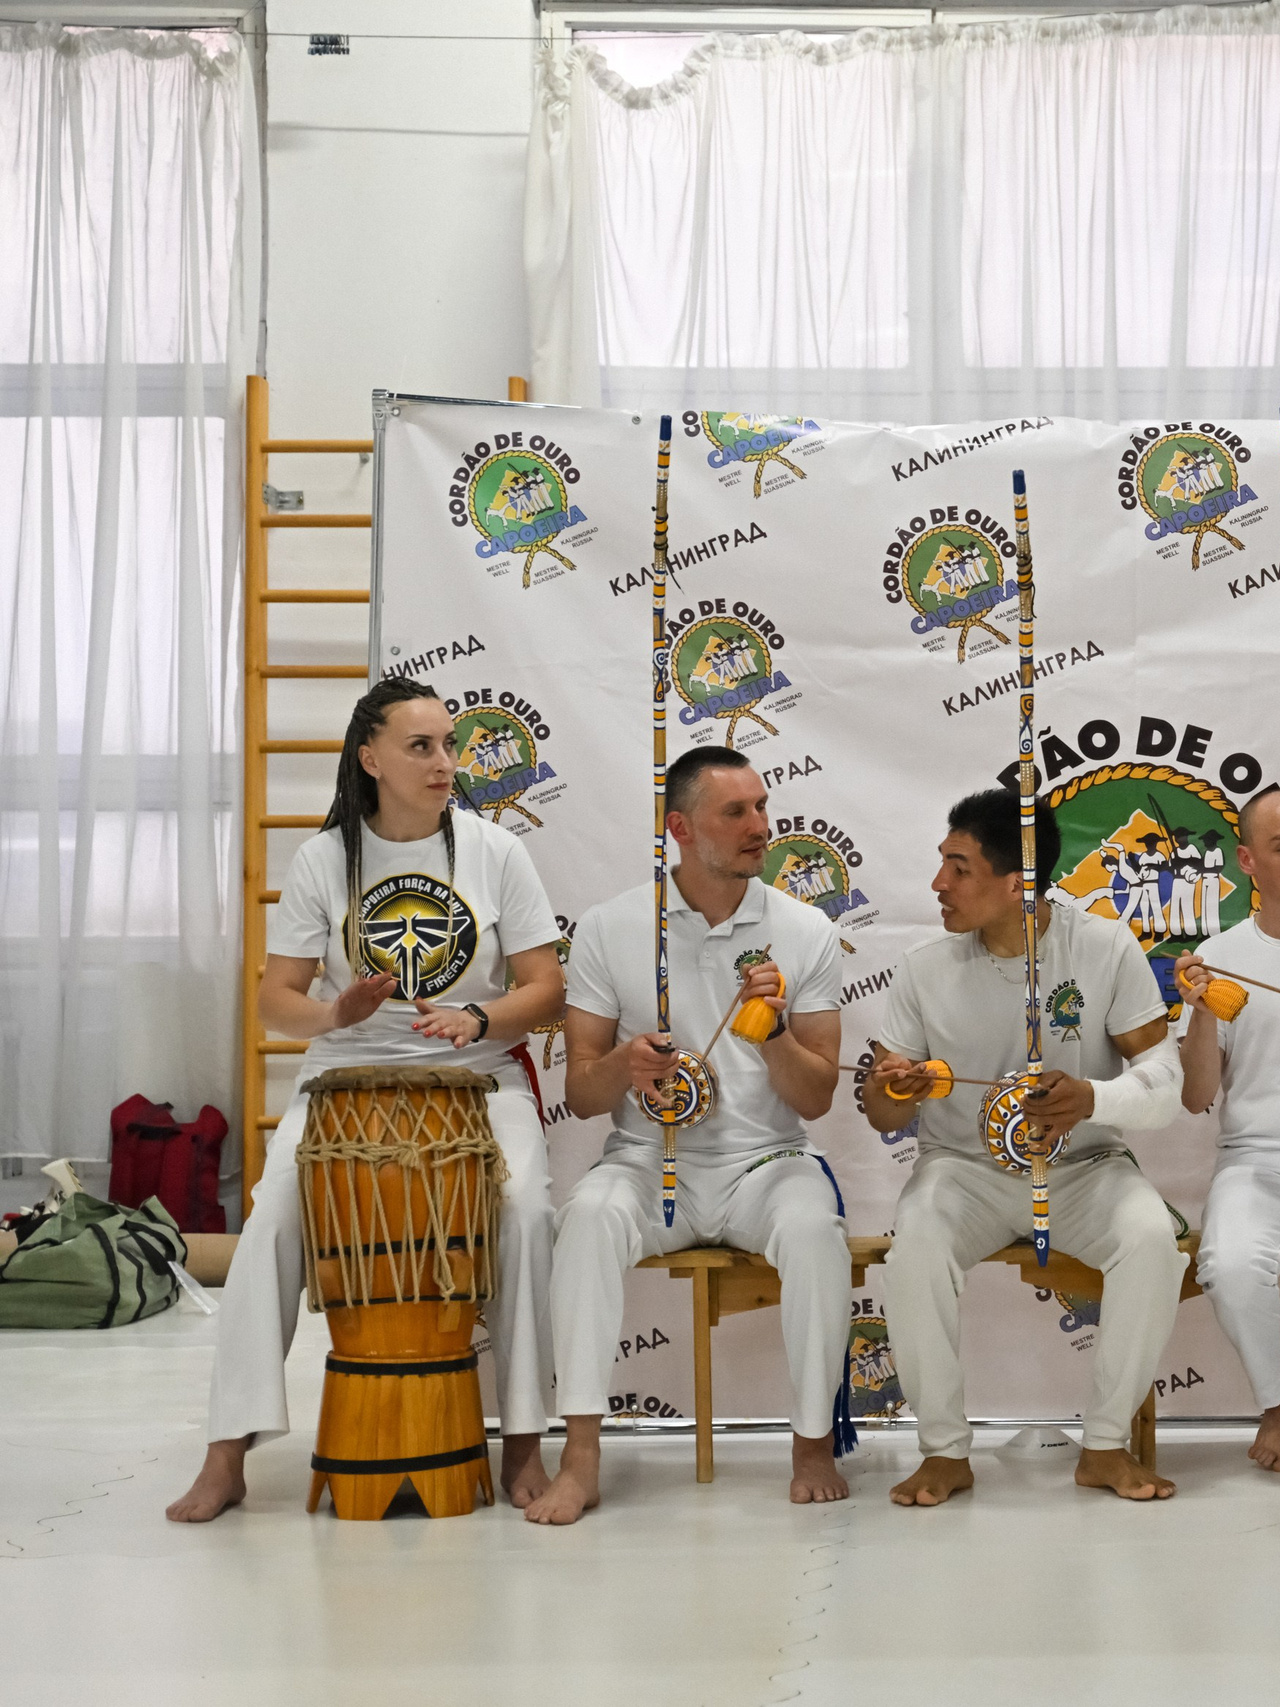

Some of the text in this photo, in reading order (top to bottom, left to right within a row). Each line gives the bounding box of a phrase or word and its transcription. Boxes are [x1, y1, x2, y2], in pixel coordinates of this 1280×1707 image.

[449, 432, 580, 527] CORDÃO DE OURO
[1118, 422, 1251, 510] CORDÃO DE OURO
[475, 505, 588, 559] CAPOEIRA
[1145, 484, 1258, 541] CAPOEIRA
[608, 520, 767, 596] КАЛНИНГРАД
[883, 506, 1017, 604] CORDÃO DE OURO
[698, 598, 785, 650] DE OURO
[911, 579, 1020, 634] CAPOEIRA
[464, 688, 492, 707] DE
[499, 692, 550, 740] OURO
[679, 671, 792, 725] CAPOEIRA
[1136, 716, 1213, 768] DE
[776, 816, 863, 868] DE OURO
[399, 878, 431, 892] FORÇA
[434, 887, 450, 900] DA
[426, 949, 468, 992] FIREFLY
